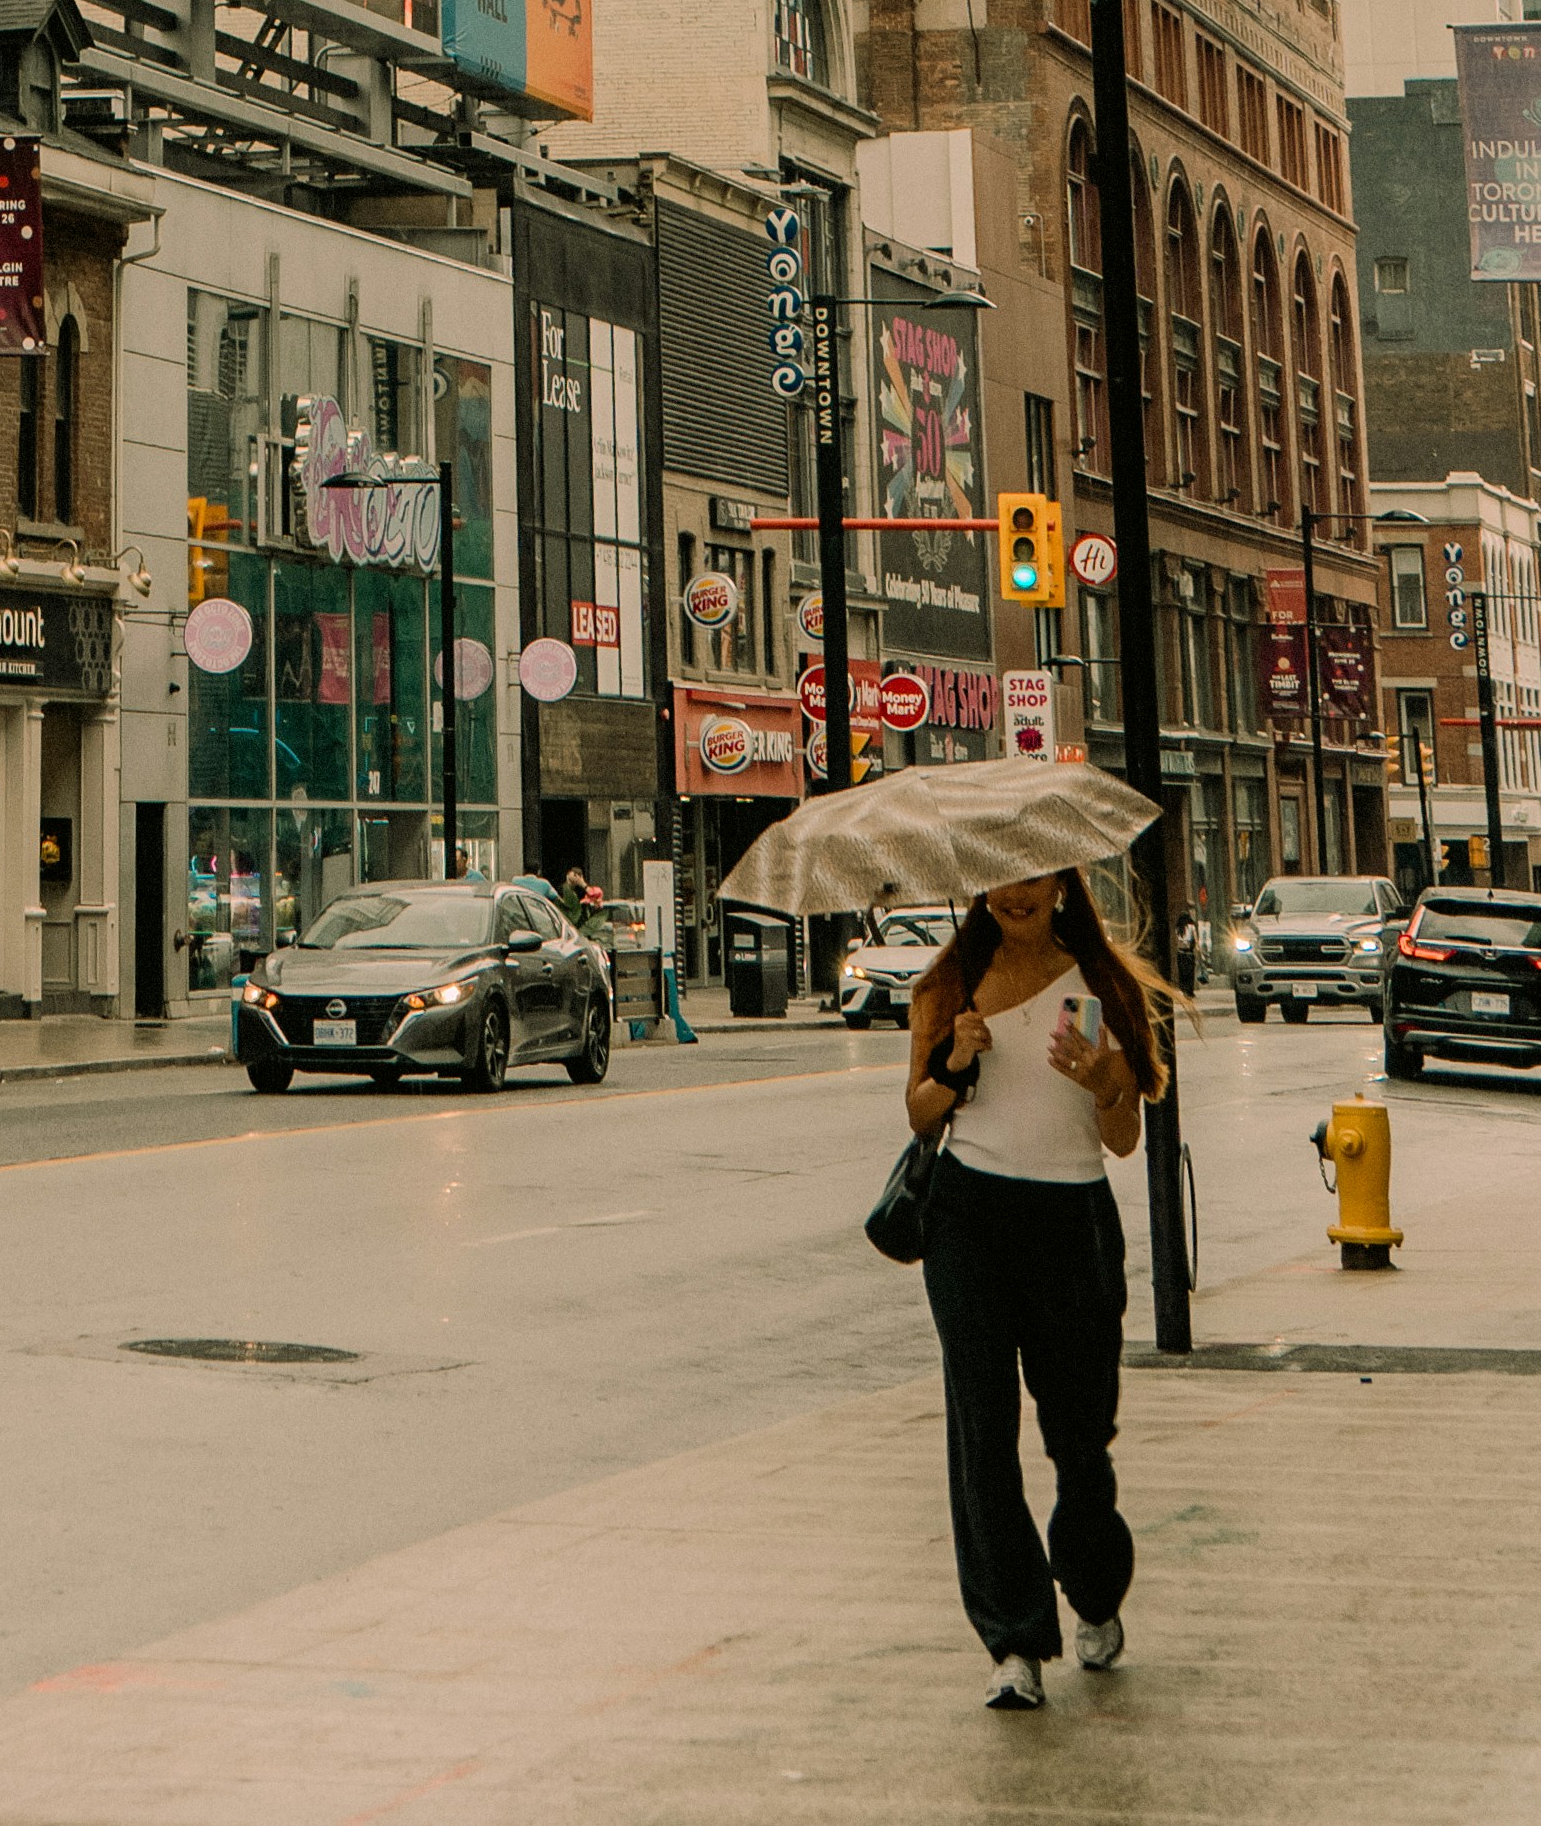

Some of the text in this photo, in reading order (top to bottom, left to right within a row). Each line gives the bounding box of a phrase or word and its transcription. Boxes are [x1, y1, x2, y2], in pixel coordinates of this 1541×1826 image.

[1516, 162, 1539, 180] IN
[1, 213, 15, 225] 26
[767, 209, 801, 398] Yonge
[541, 309, 564, 361] For
[892, 316, 958, 378] STAG SHOP
[542, 358, 581, 413] Lease
[814, 307, 833, 445] DOWNTOWN
[1079, 546, 1109, 575] Hi
[690, 586, 727, 602] BURGER
[885, 572, 921, 609] Celebrating
[930, 580, 947, 608] Years
[955, 585, 980, 614] Pleasure
[1444, 542, 1465, 650] Yonge
[692, 595, 729, 614] KING
[573, 606, 618, 643] LEASED
[1272, 611, 1293, 620] FOR
[8, 662, 37, 675] KITCHEN
[1009, 678, 1045, 691] STAG
[1269, 679, 1300, 690] TIMBIT
[882, 690, 922, 707] Money
[958, 671, 1000, 731] SHOP
[1008, 694, 1048, 707] SHOP
[887, 703, 919, 716] Mart
[1013, 715, 1044, 726] adult
[707, 730, 744, 747] BURGER
[766, 732, 793, 763] KING
[709, 740, 746, 759] KING
